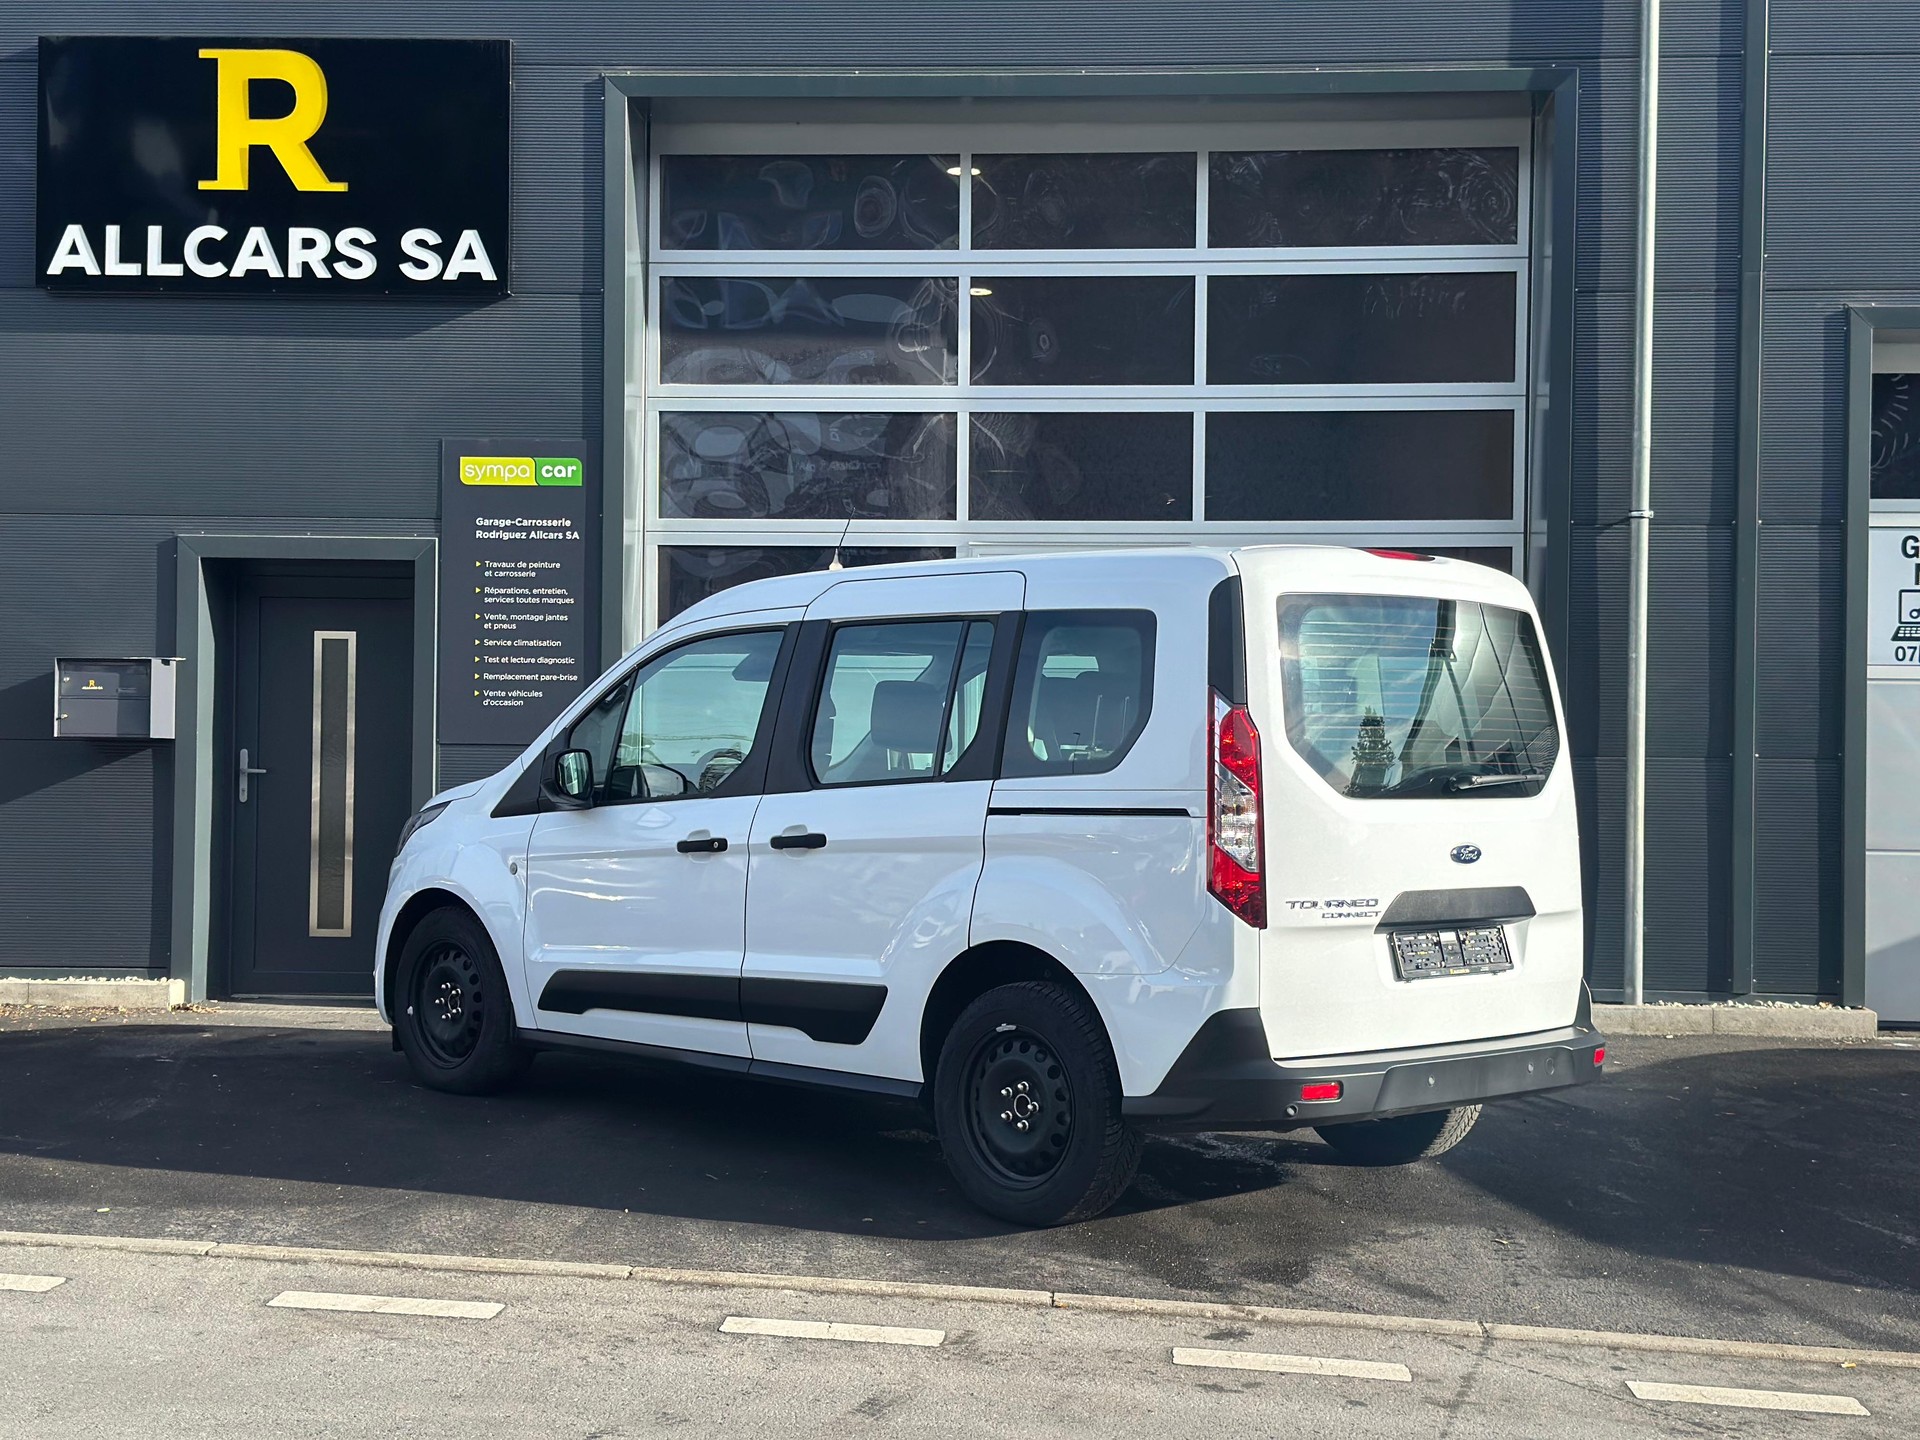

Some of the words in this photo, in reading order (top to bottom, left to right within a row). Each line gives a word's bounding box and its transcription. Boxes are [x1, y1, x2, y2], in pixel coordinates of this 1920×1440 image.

[198, 48, 348, 192] R
[46, 224, 377, 280] ALLCARS
[399, 227, 498, 282] SA
[465, 464, 530, 482] sympa
[541, 464, 577, 478] car
[475, 517, 572, 528] Garage-Carrosserie
[475, 530, 527, 540] Rodriguez
[529, 530, 563, 540] Allcars
[565, 531, 580, 540] SA
[484, 560, 515, 568] Travaux
[528, 561, 561, 569] peinture
[484, 587, 531, 596] Réparations,
[484, 613, 508, 621] Vente,
[510, 614, 544, 622] montage
[545, 614, 568, 622] jantes
[513, 639, 561, 647] climatisation
[1895, 646, 1920, 662] 07
[510, 656, 535, 664] lecture
[537, 657, 575, 665] diagnostic
[483, 673, 539, 681] Remplacement
[540, 673, 578, 681] pare-brise
[1285, 898, 1379, 909] TOURNEO
[1321, 910, 1382, 919] CONNECT
